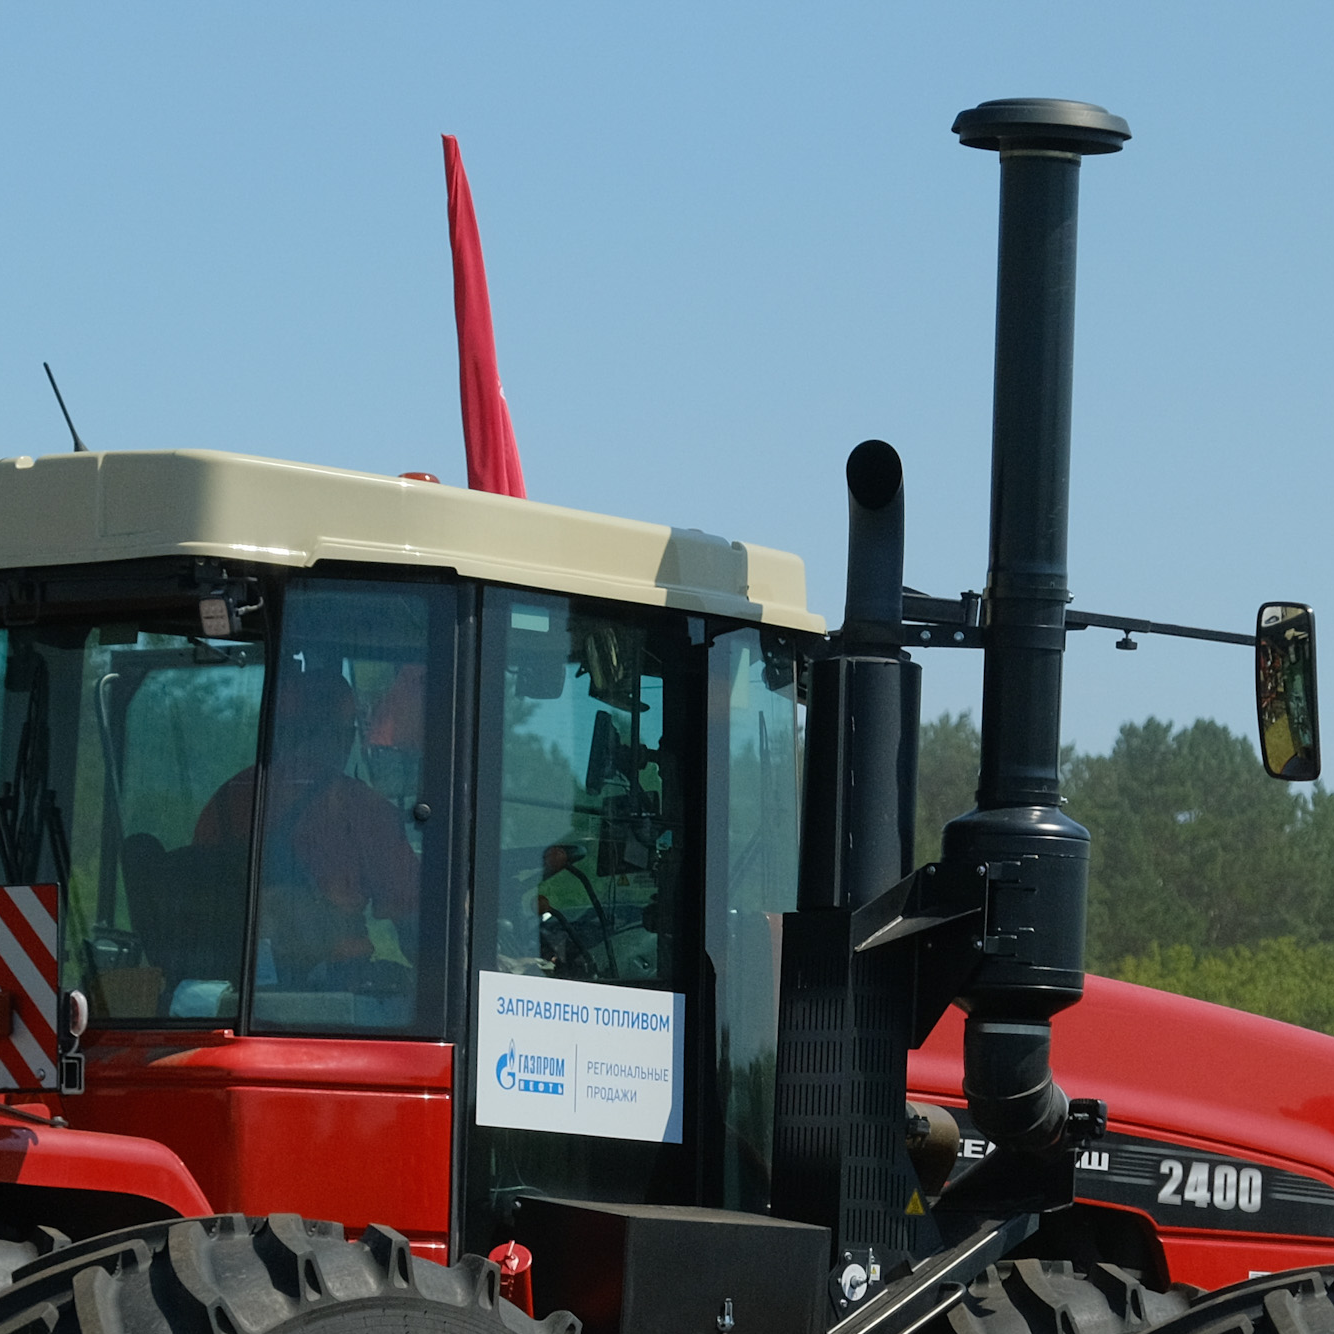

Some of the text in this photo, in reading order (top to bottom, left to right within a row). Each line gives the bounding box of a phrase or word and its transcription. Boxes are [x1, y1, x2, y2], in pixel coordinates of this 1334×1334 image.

[496, 996, 670, 1033] ЗАПРАВЛЕНО ТОПЛИВОМ
[518, 1054, 565, 1077] ГАЗПРОМ
[587, 1060, 669, 1082] РЕГИОНАЛЬНЫЕ
[519, 1080, 564, 1095] НЕФТЬ
[586, 1085, 637, 1104] ПРОДАЖИ
[1157, 1159, 1263, 1213] 2400
